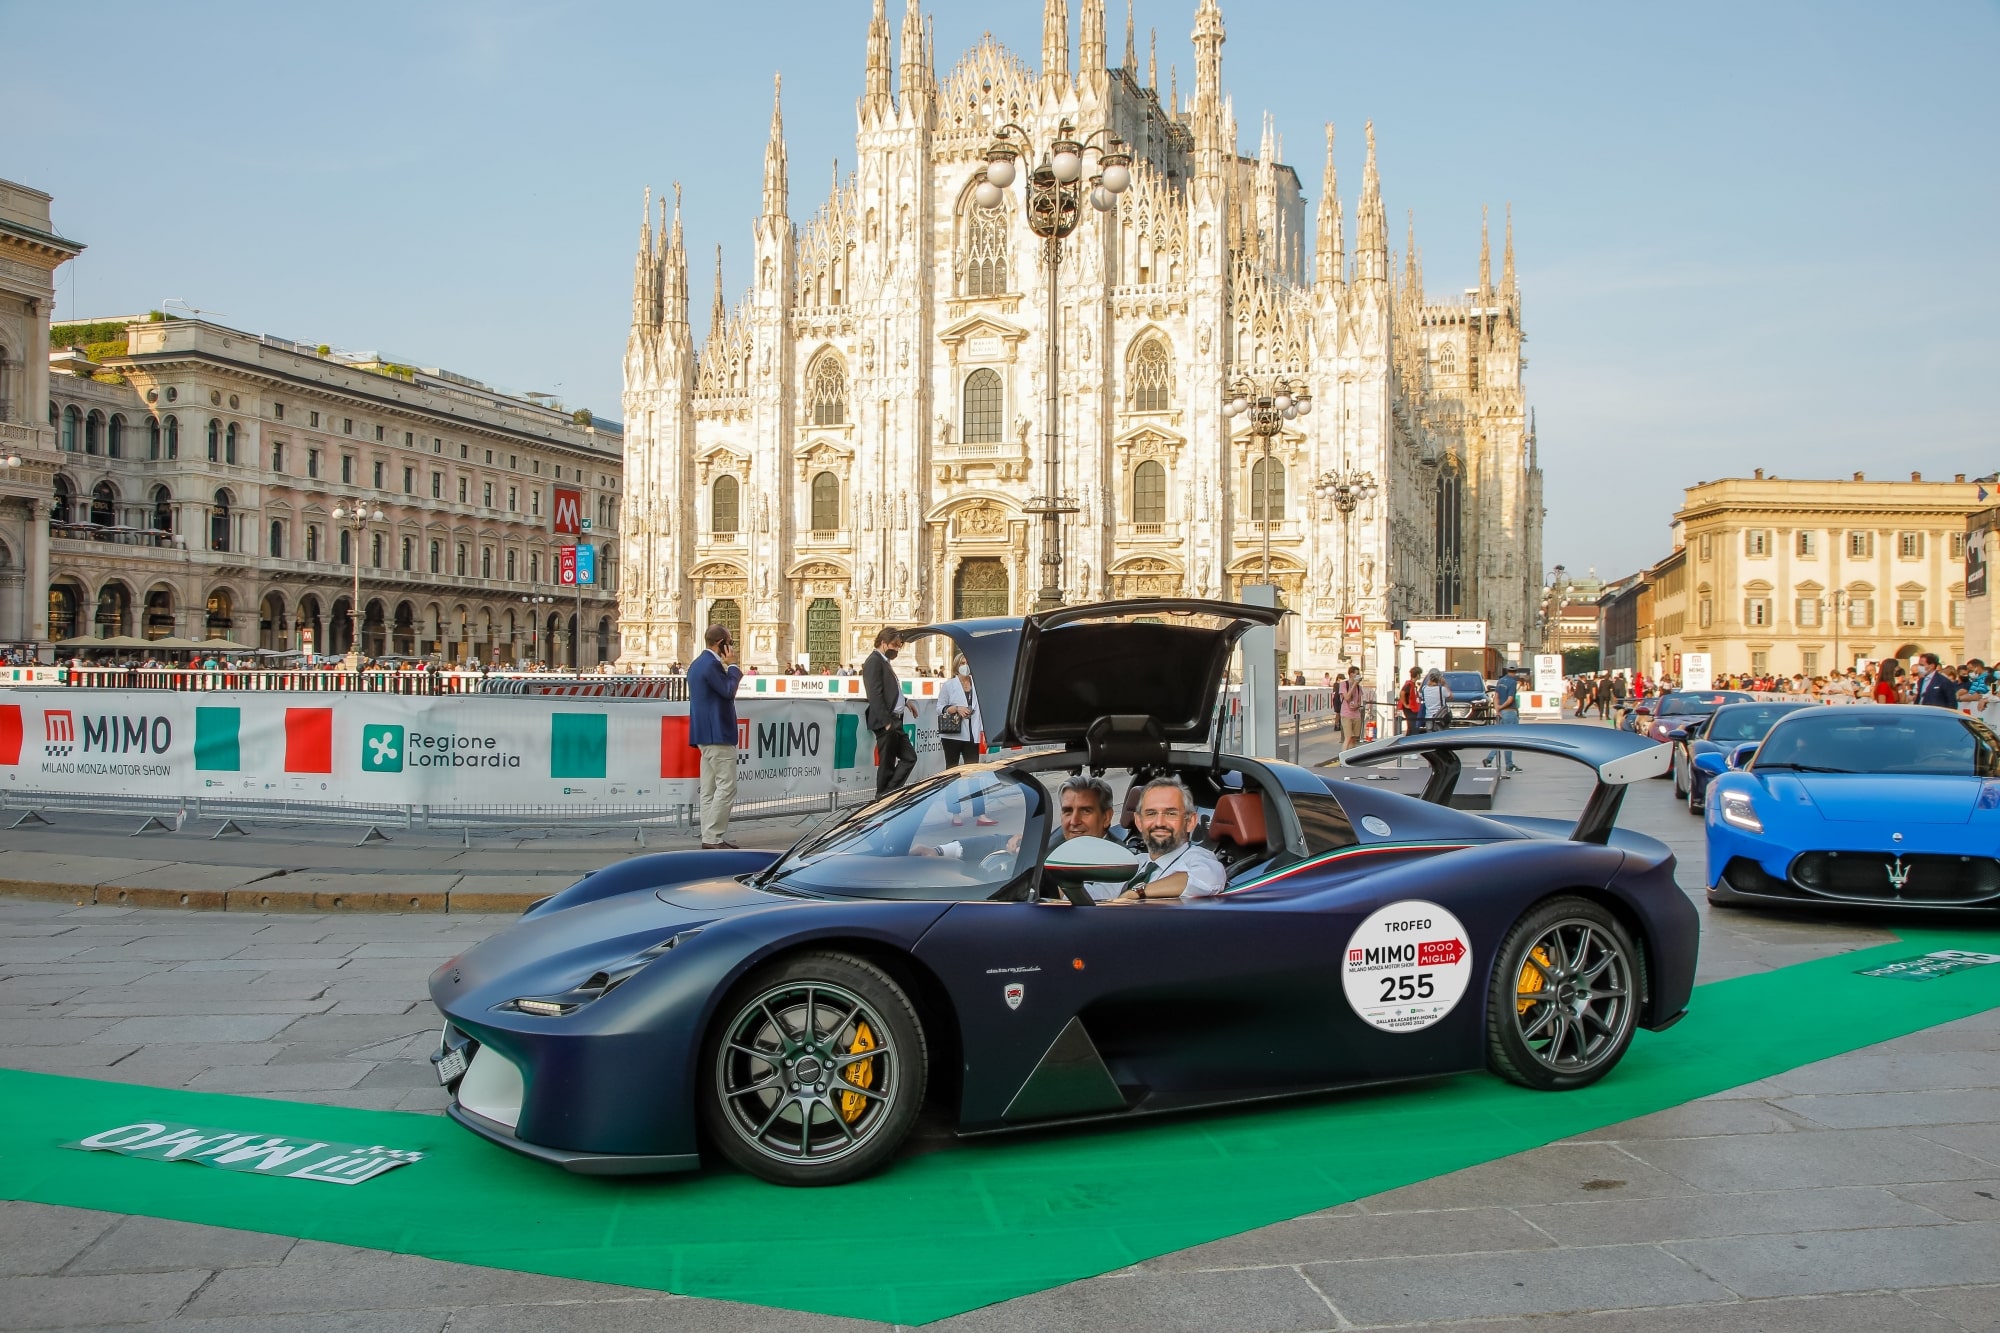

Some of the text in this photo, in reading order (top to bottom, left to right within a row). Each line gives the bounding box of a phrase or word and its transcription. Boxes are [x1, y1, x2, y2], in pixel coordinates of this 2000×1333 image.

[556, 498, 579, 532] M
[1346, 619, 1360, 629] M
[801, 681, 824, 690] MIMO
[82, 715, 172, 754] MIMO
[409, 733, 497, 752] Regione
[757, 722, 820, 759] MIMO
[409, 752, 520, 768] Lombardia
[42, 762, 171, 777] MILANO MONZA MOTOR SHOW
[755, 768, 777, 780] MONZA
[778, 766, 803, 778] MOTOR
[804, 766, 821, 776] SHOW
[1385, 919, 1432, 932] TROFEO
[1365, 944, 1415, 965] MIMO
[1424, 943, 1454, 953] 1000
[1420, 953, 1455, 964] MIGLIA
[1380, 973, 1434, 1002] 255
[81, 1124, 329, 1171] MIMO
